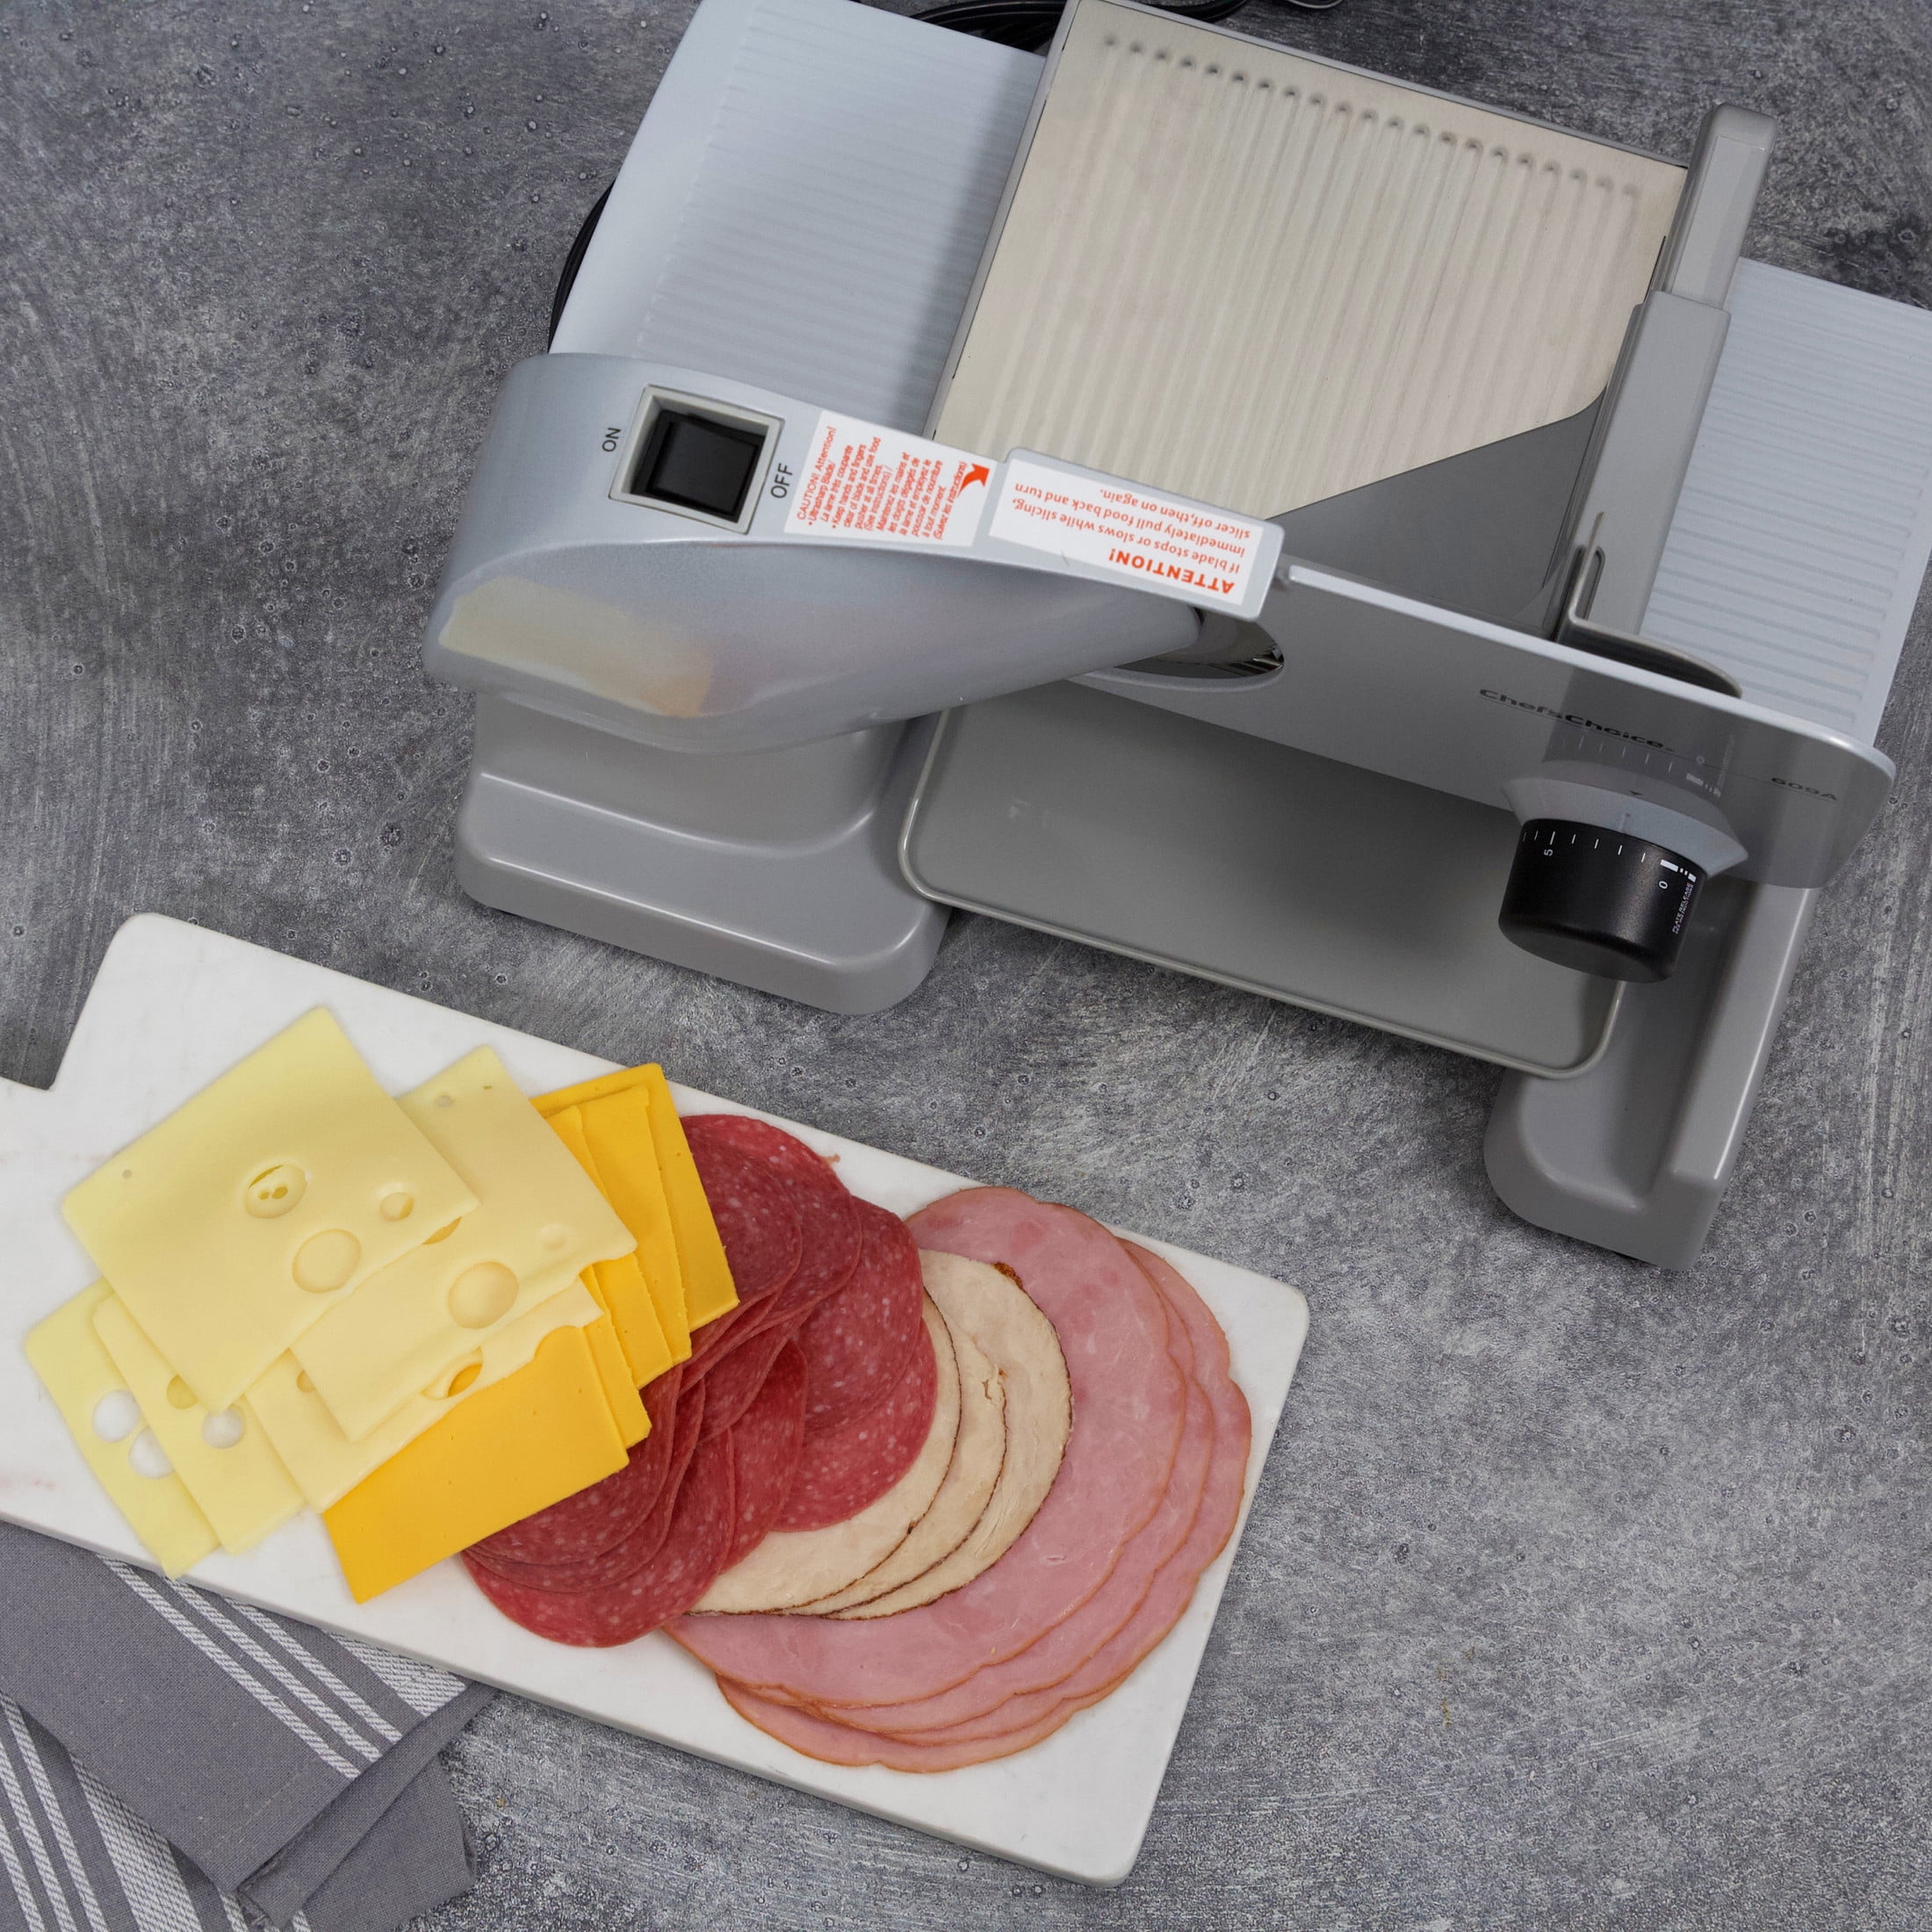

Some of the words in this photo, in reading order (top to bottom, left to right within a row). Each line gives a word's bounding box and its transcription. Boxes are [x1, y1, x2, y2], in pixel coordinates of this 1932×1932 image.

[602, 428, 621, 452] ON
[770, 463, 793, 499] OFF
[797, 472, 820, 521] CAUTION!
[814, 426, 836, 472] Attention!
[1014, 484, 1042, 499] turn
[1043, 492, 1070, 505] and
[1099, 489, 1139, 508] again.
[1012, 498, 1057, 520] slicing,
[1071, 499, 1102, 517] back
[1140, 501, 1158, 512] on
[1058, 514, 1095, 530] while
[1102, 508, 1135, 527] food
[1135, 518, 1164, 532] pull
[1098, 524, 1135, 543] slows
[1164, 523, 1245, 558] immediately
[1214, 523, 1251, 539] slicer
[1136, 537, 1152, 546] or
[1154, 541, 1189, 558] stops
[1191, 551, 1229, 571] blade
[1107, 548, 1236, 595] ATTENTION!
